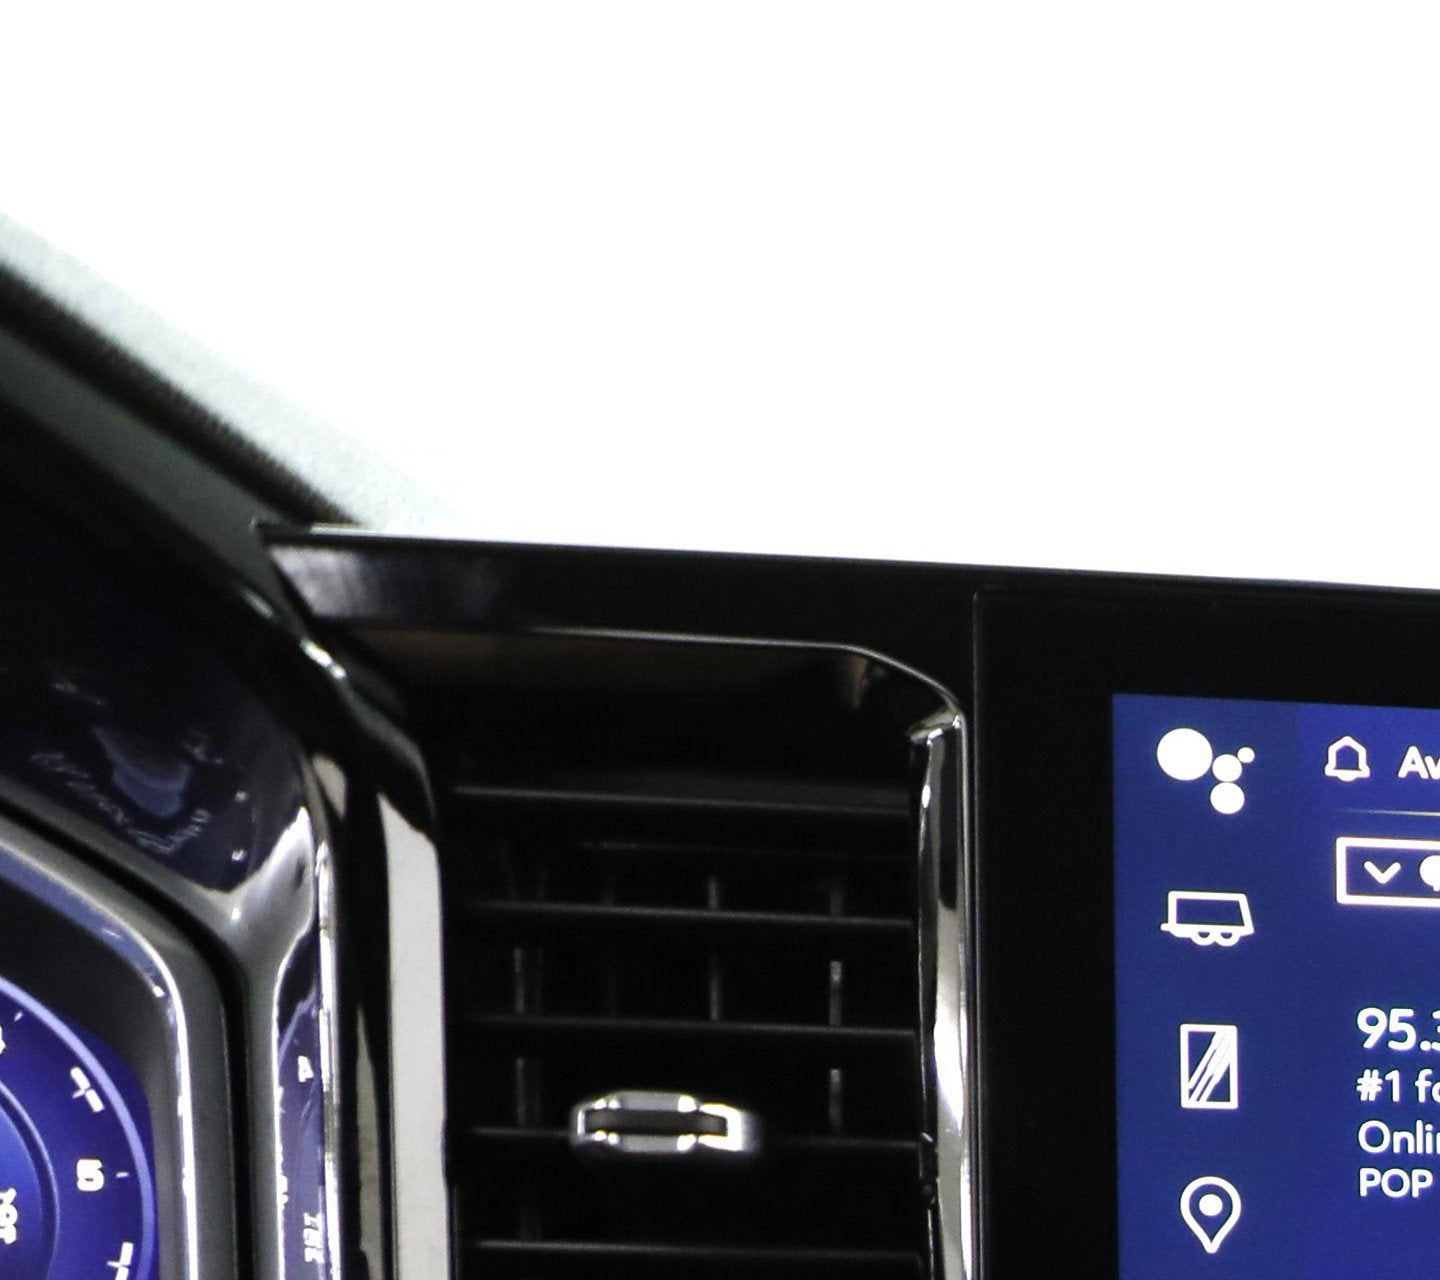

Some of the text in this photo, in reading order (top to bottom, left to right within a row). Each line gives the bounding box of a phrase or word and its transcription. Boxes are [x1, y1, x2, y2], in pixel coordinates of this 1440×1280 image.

[1356, 1068, 1401, 1103] #1
[76, 1158, 105, 1192] 5
[1359, 1167, 1434, 1198] POP
